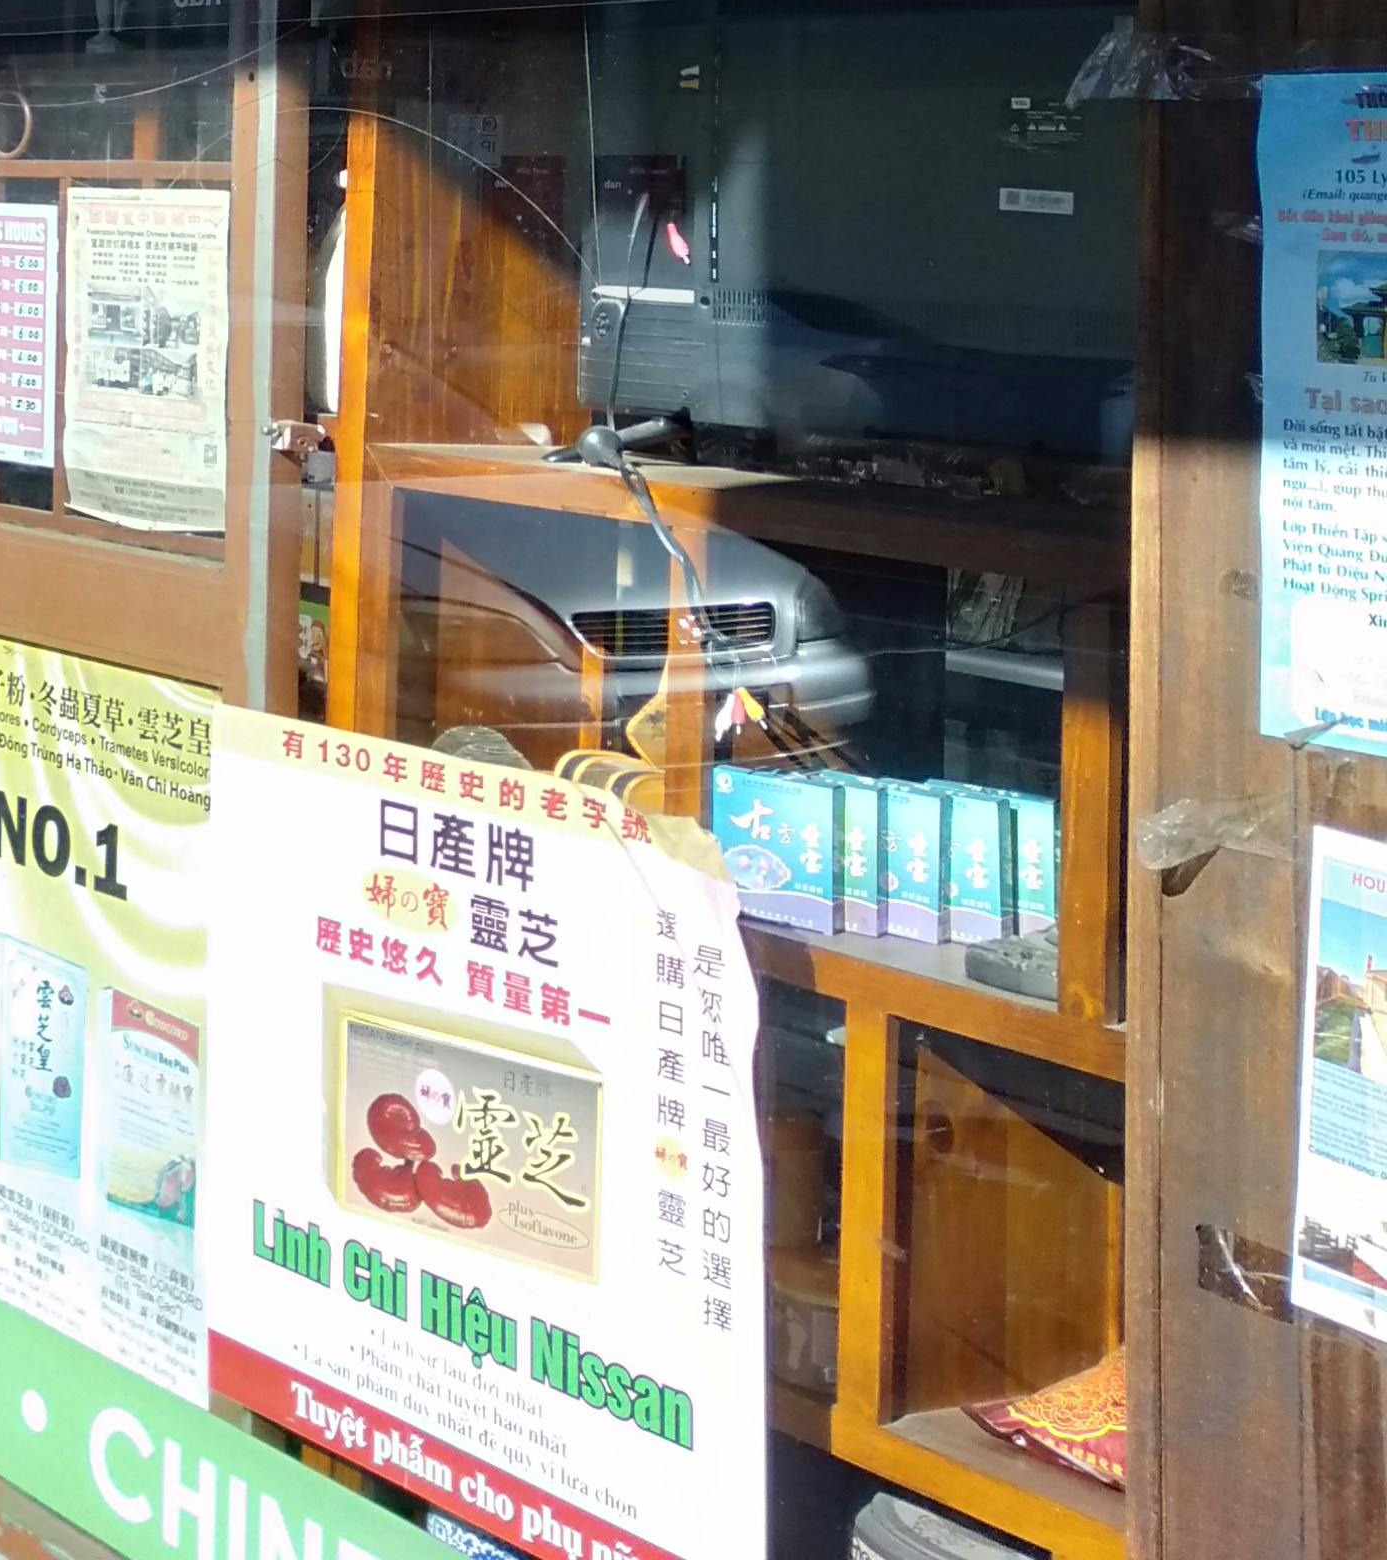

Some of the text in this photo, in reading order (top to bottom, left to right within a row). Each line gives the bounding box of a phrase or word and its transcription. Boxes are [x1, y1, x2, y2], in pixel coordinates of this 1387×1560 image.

[1335, 169, 1365, 183] 105
[5, 221, 45, 243] HOURS
[32, 718, 87, 746] Cordyceps
[99, 736, 148, 762] Trametes
[152, 749, 209, 779] Versicolor
[146, 775, 167, 796] Chi
[170, 781, 211, 812] Hoàng
[380, 799, 535, 892] 日產牌
[471, 895, 560, 968] 靈芝
[317, 916, 611, 1027] 歷史悠久 質量第一
[508, 1200, 534, 1216] plus
[514, 1215, 578, 1244] Isoflavone
[253, 1198, 693, 1452] Linh Chi Hiệu Nissan
[291, 1381, 583, 1560] Tuyệt phẩm cho phụ
